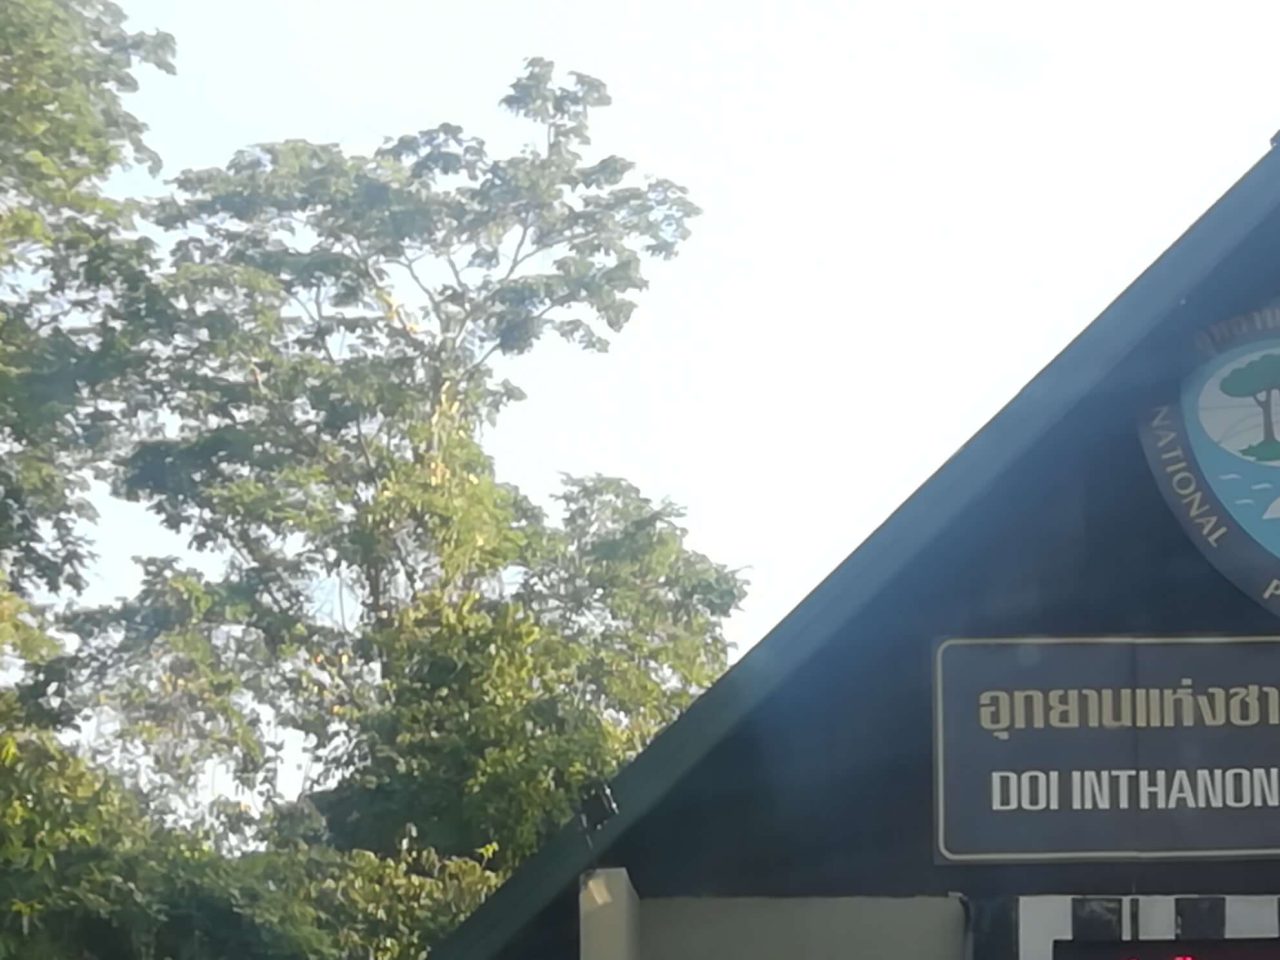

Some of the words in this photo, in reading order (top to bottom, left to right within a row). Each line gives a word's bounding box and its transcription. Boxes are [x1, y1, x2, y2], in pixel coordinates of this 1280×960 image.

[1150, 404, 1230, 549] NATIONAL
[991, 770, 1059, 811] DOI
[1071, 767, 1279, 810] INTHANON
